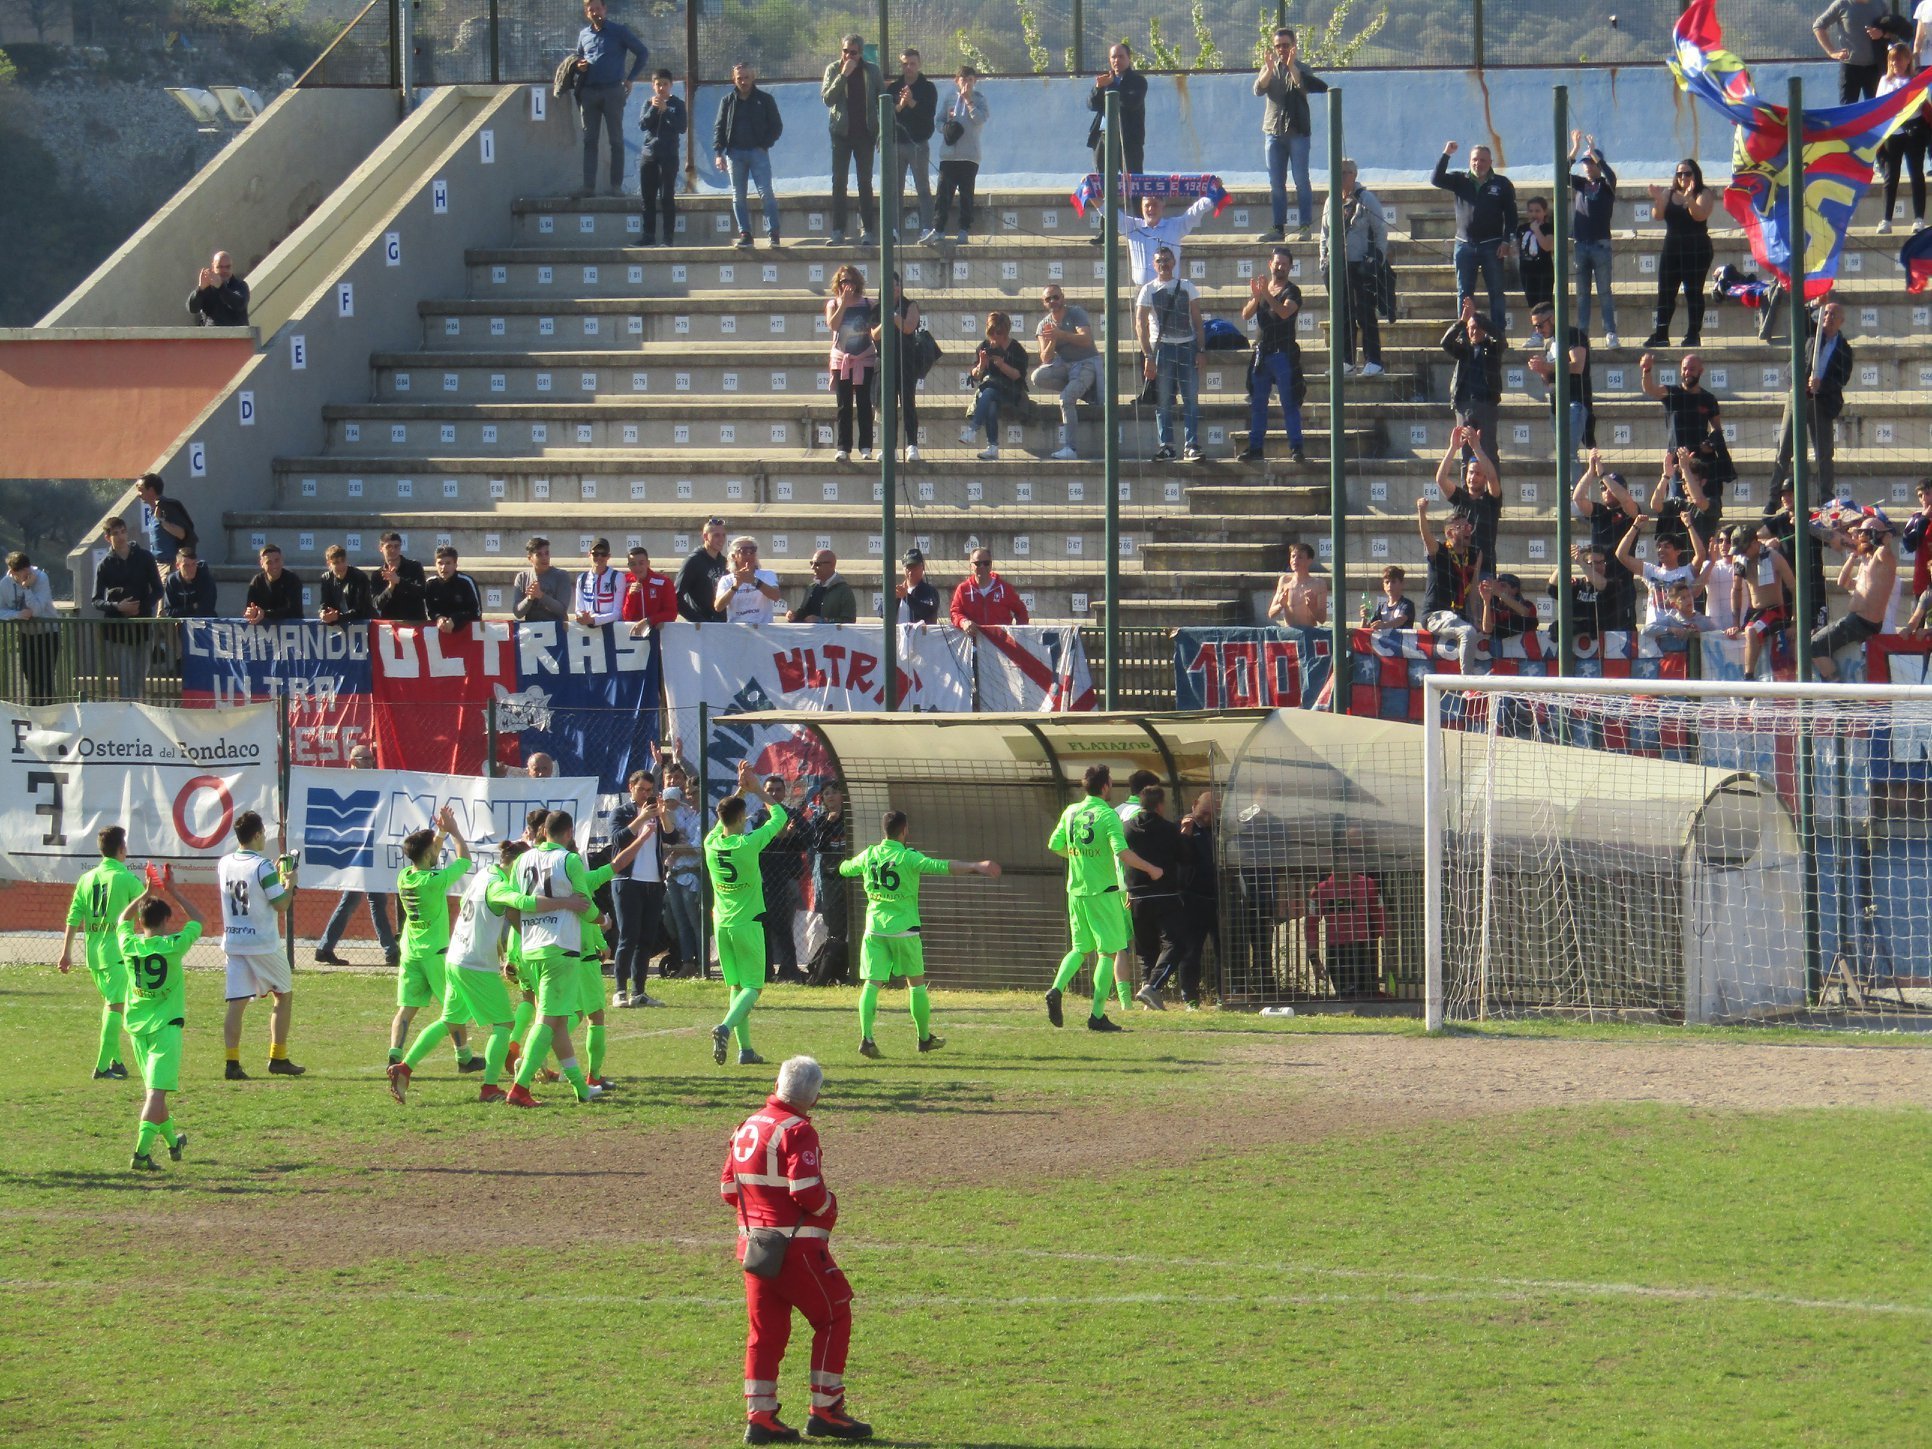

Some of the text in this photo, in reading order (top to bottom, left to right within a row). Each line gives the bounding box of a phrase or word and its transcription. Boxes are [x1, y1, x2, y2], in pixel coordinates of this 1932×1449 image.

[536, 97, 542, 114] L
[486, 140, 489, 157] I
[436, 190, 445, 207] H
[388, 242, 398, 260] G
[342, 292, 349, 310] F
[296, 345, 302, 363] E
[242, 401, 252, 419] D
[193, 452, 203, 470] C
[185, 621, 370, 661] COMMANDO
[378, 621, 652, 679] ULTRAS
[78, 738, 153, 757] Osteria
[160, 747, 176, 758] del
[1070, 810, 1095, 845] 13
[717, 850, 738, 882] 5
[871, 861, 900, 891] 16
[92, 883, 108, 918] 11
[522, 916, 558, 926] macron
[133, 953, 168, 990] 19
